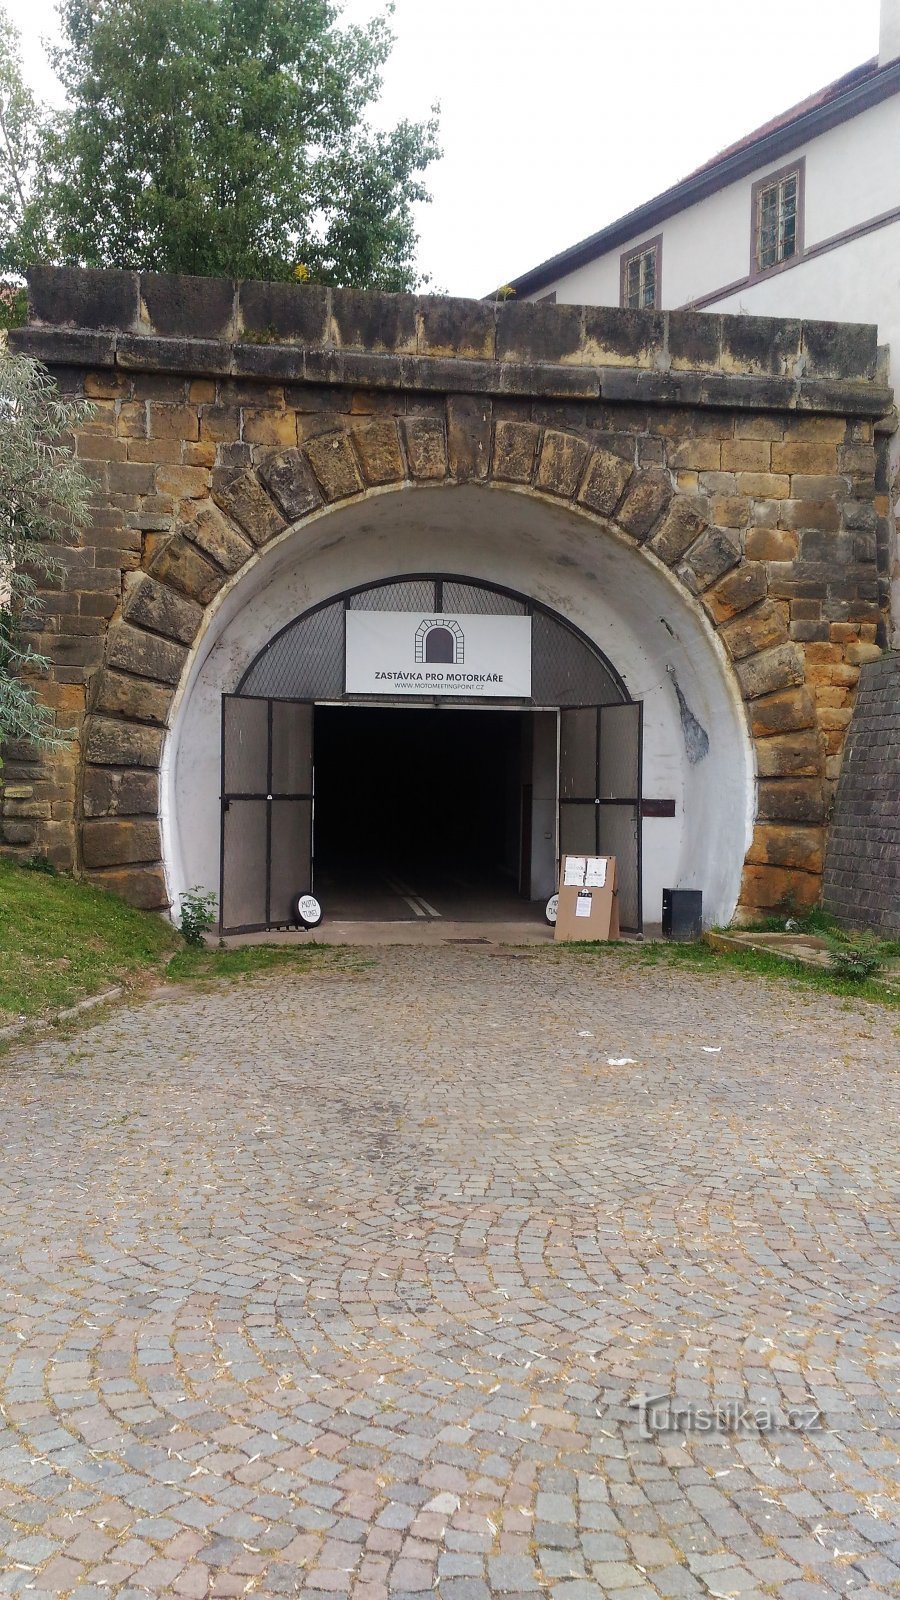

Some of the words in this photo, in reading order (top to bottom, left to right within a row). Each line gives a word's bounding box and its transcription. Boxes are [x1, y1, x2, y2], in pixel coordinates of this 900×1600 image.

[375, 671, 423, 680] ZASTÁVKA
[425, 673, 444, 681] PRO
[446, 673, 503, 683] MOTORKÁŘE
[394, 682, 485, 690] WWW.MOTOMEETINGPOINT.CZ
